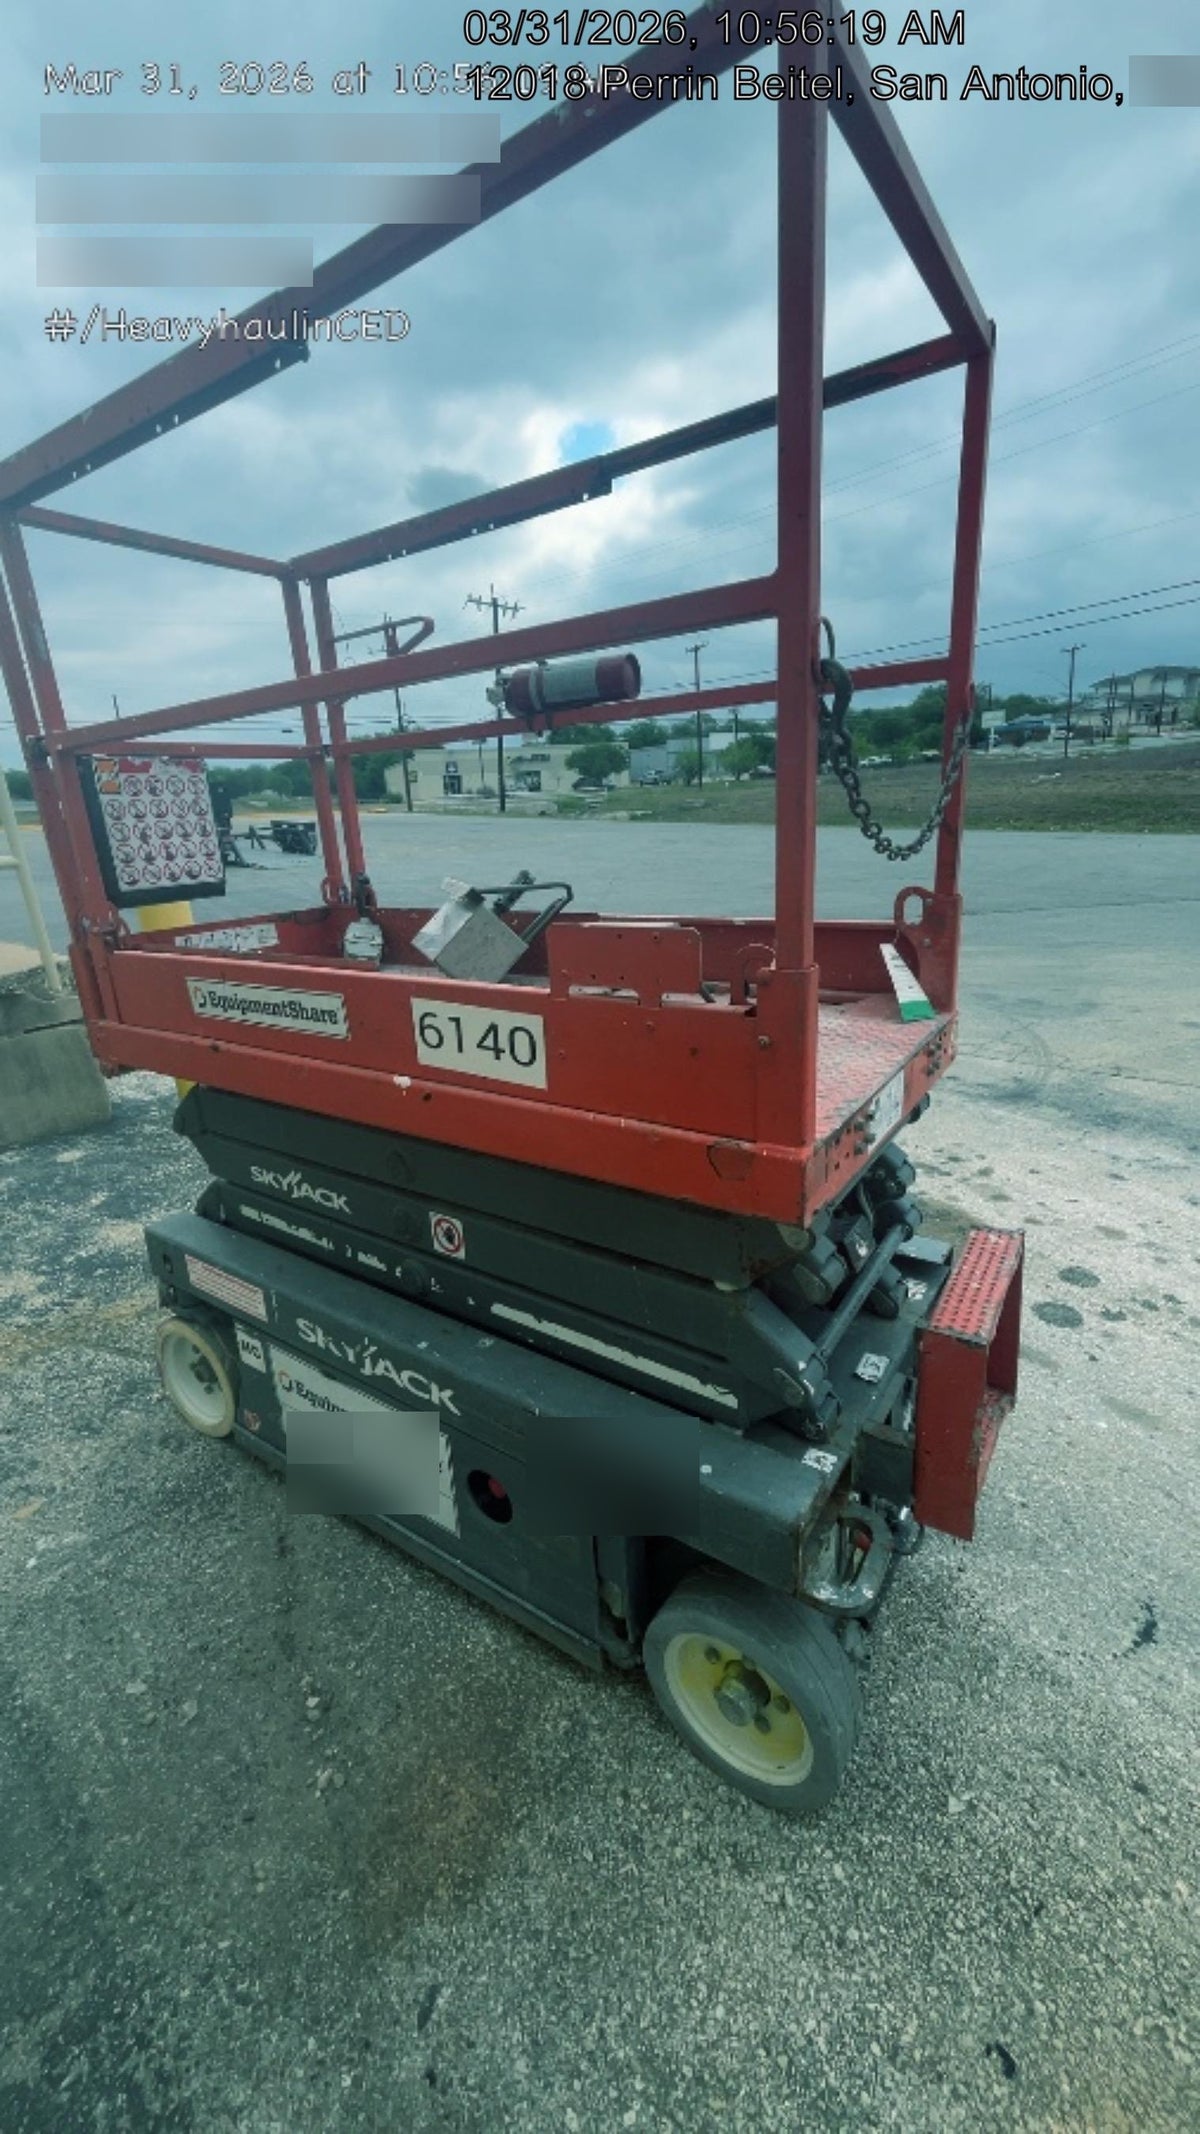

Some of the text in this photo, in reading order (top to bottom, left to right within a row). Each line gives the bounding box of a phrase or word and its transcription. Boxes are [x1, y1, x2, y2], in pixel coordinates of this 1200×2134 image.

[208, 991, 339, 1024] EquipmentShare
[419, 1011, 537, 1067] 6140
[251, 1166, 352, 1214] SKYJACK
[296, 1317, 461, 1416] SKYJACK
